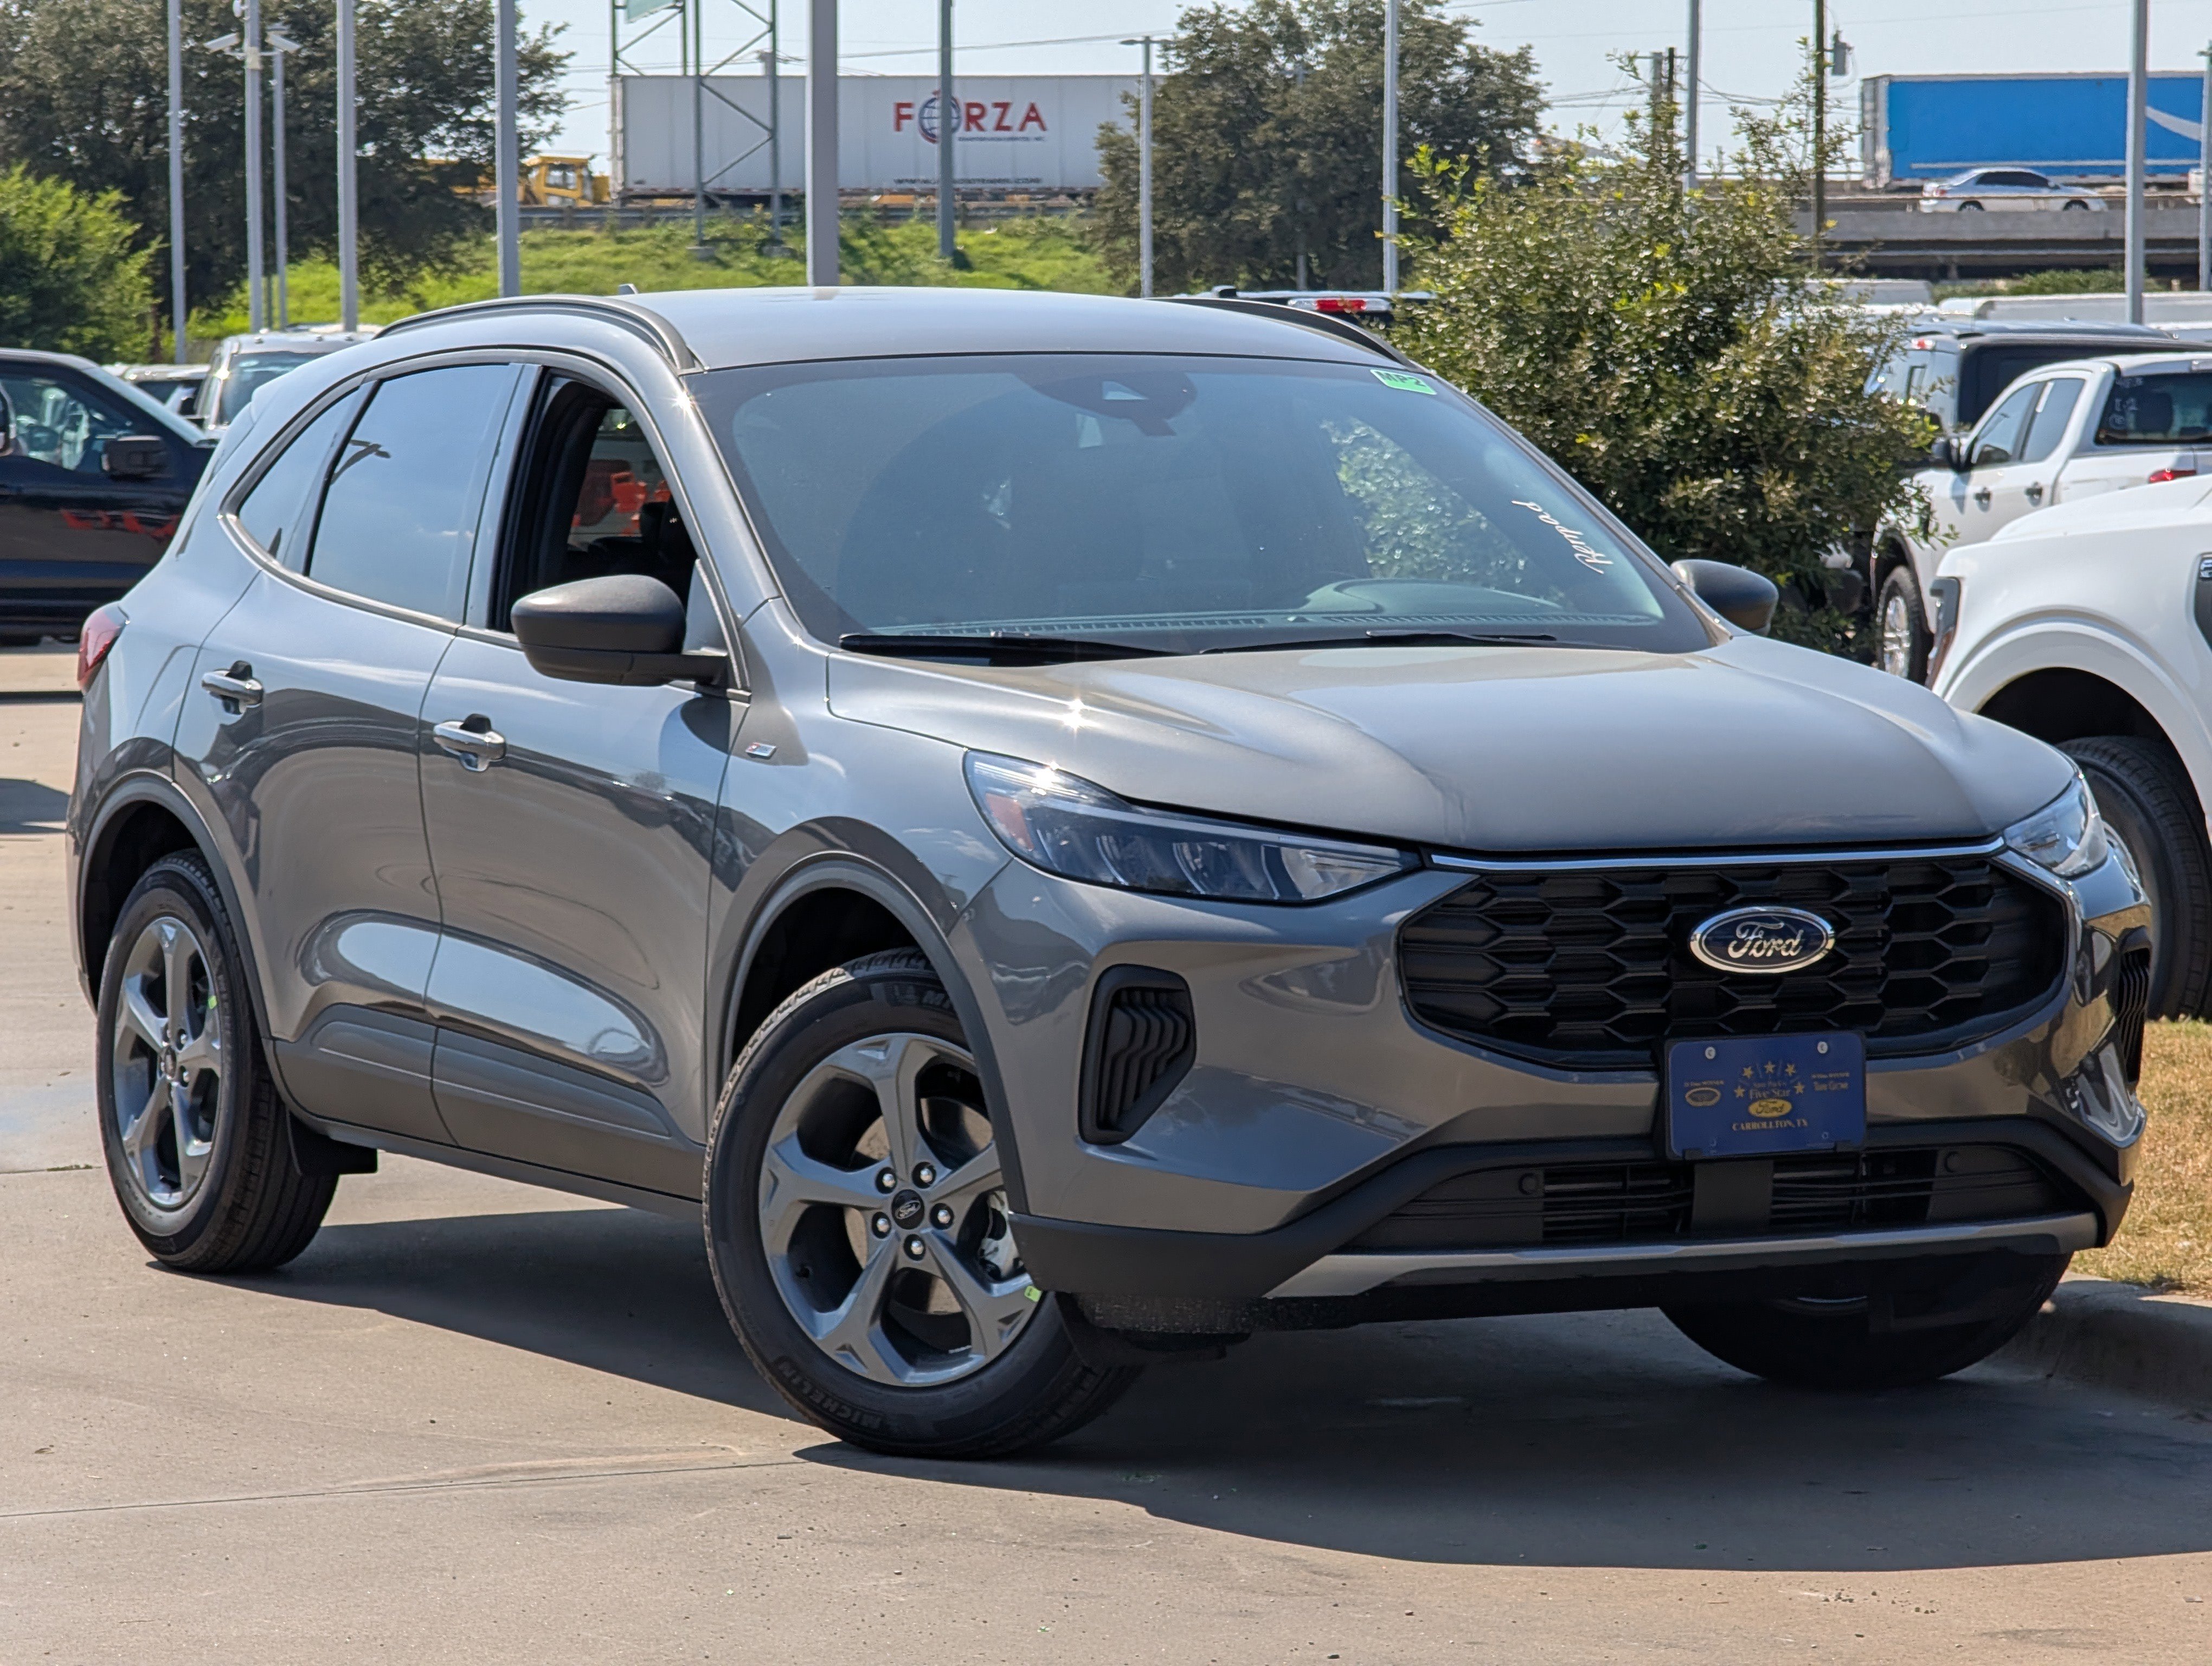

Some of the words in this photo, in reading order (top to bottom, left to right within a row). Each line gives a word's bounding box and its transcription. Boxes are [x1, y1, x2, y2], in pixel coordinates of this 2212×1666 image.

[893, 94, 1047, 143] FORZA
[1727, 921, 1804, 959] Ford
[1756, 1100, 1785, 1114] Ford
[777, 1360, 886, 1428] MICHELIN
